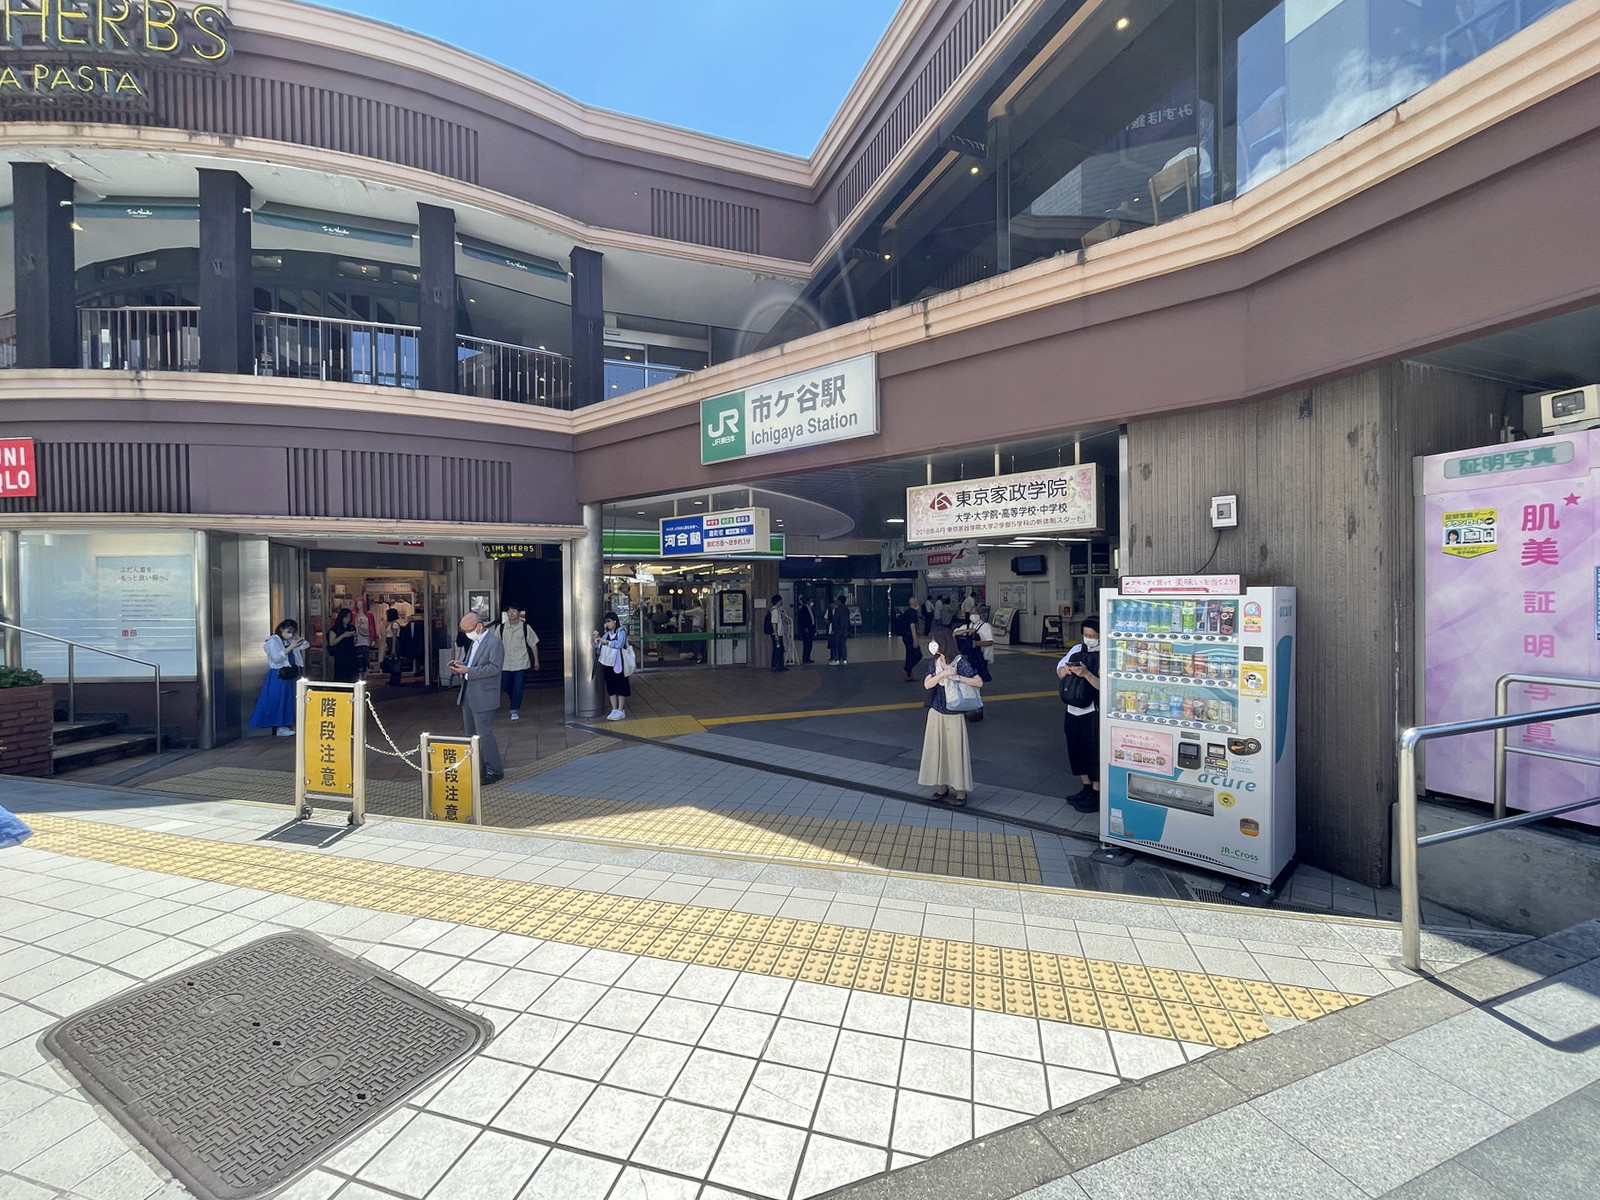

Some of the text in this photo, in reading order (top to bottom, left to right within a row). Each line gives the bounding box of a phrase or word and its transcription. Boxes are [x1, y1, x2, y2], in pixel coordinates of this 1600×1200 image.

[4, 0, 229, 62] HERBS
[33, 64, 144, 97] PASTA
[707, 408, 740, 439] JR
[750, 411, 858, 446] Ichigaya Station
[0, 446, 26, 467] NI
[1458, 446, 1557, 476] 証明写真
[0, 469, 31, 494] LO
[955, 478, 1068, 509] 東京家政学院
[507, 544, 534, 553] HERBS
[664, 532, 702, 547] 河合塾
[319, 697, 337, 788] 階段注意
[442, 748, 460, 821] 階段注意
[1197, 772, 1257, 792] acure
[1220, 845, 1259, 862] JR-Cross
